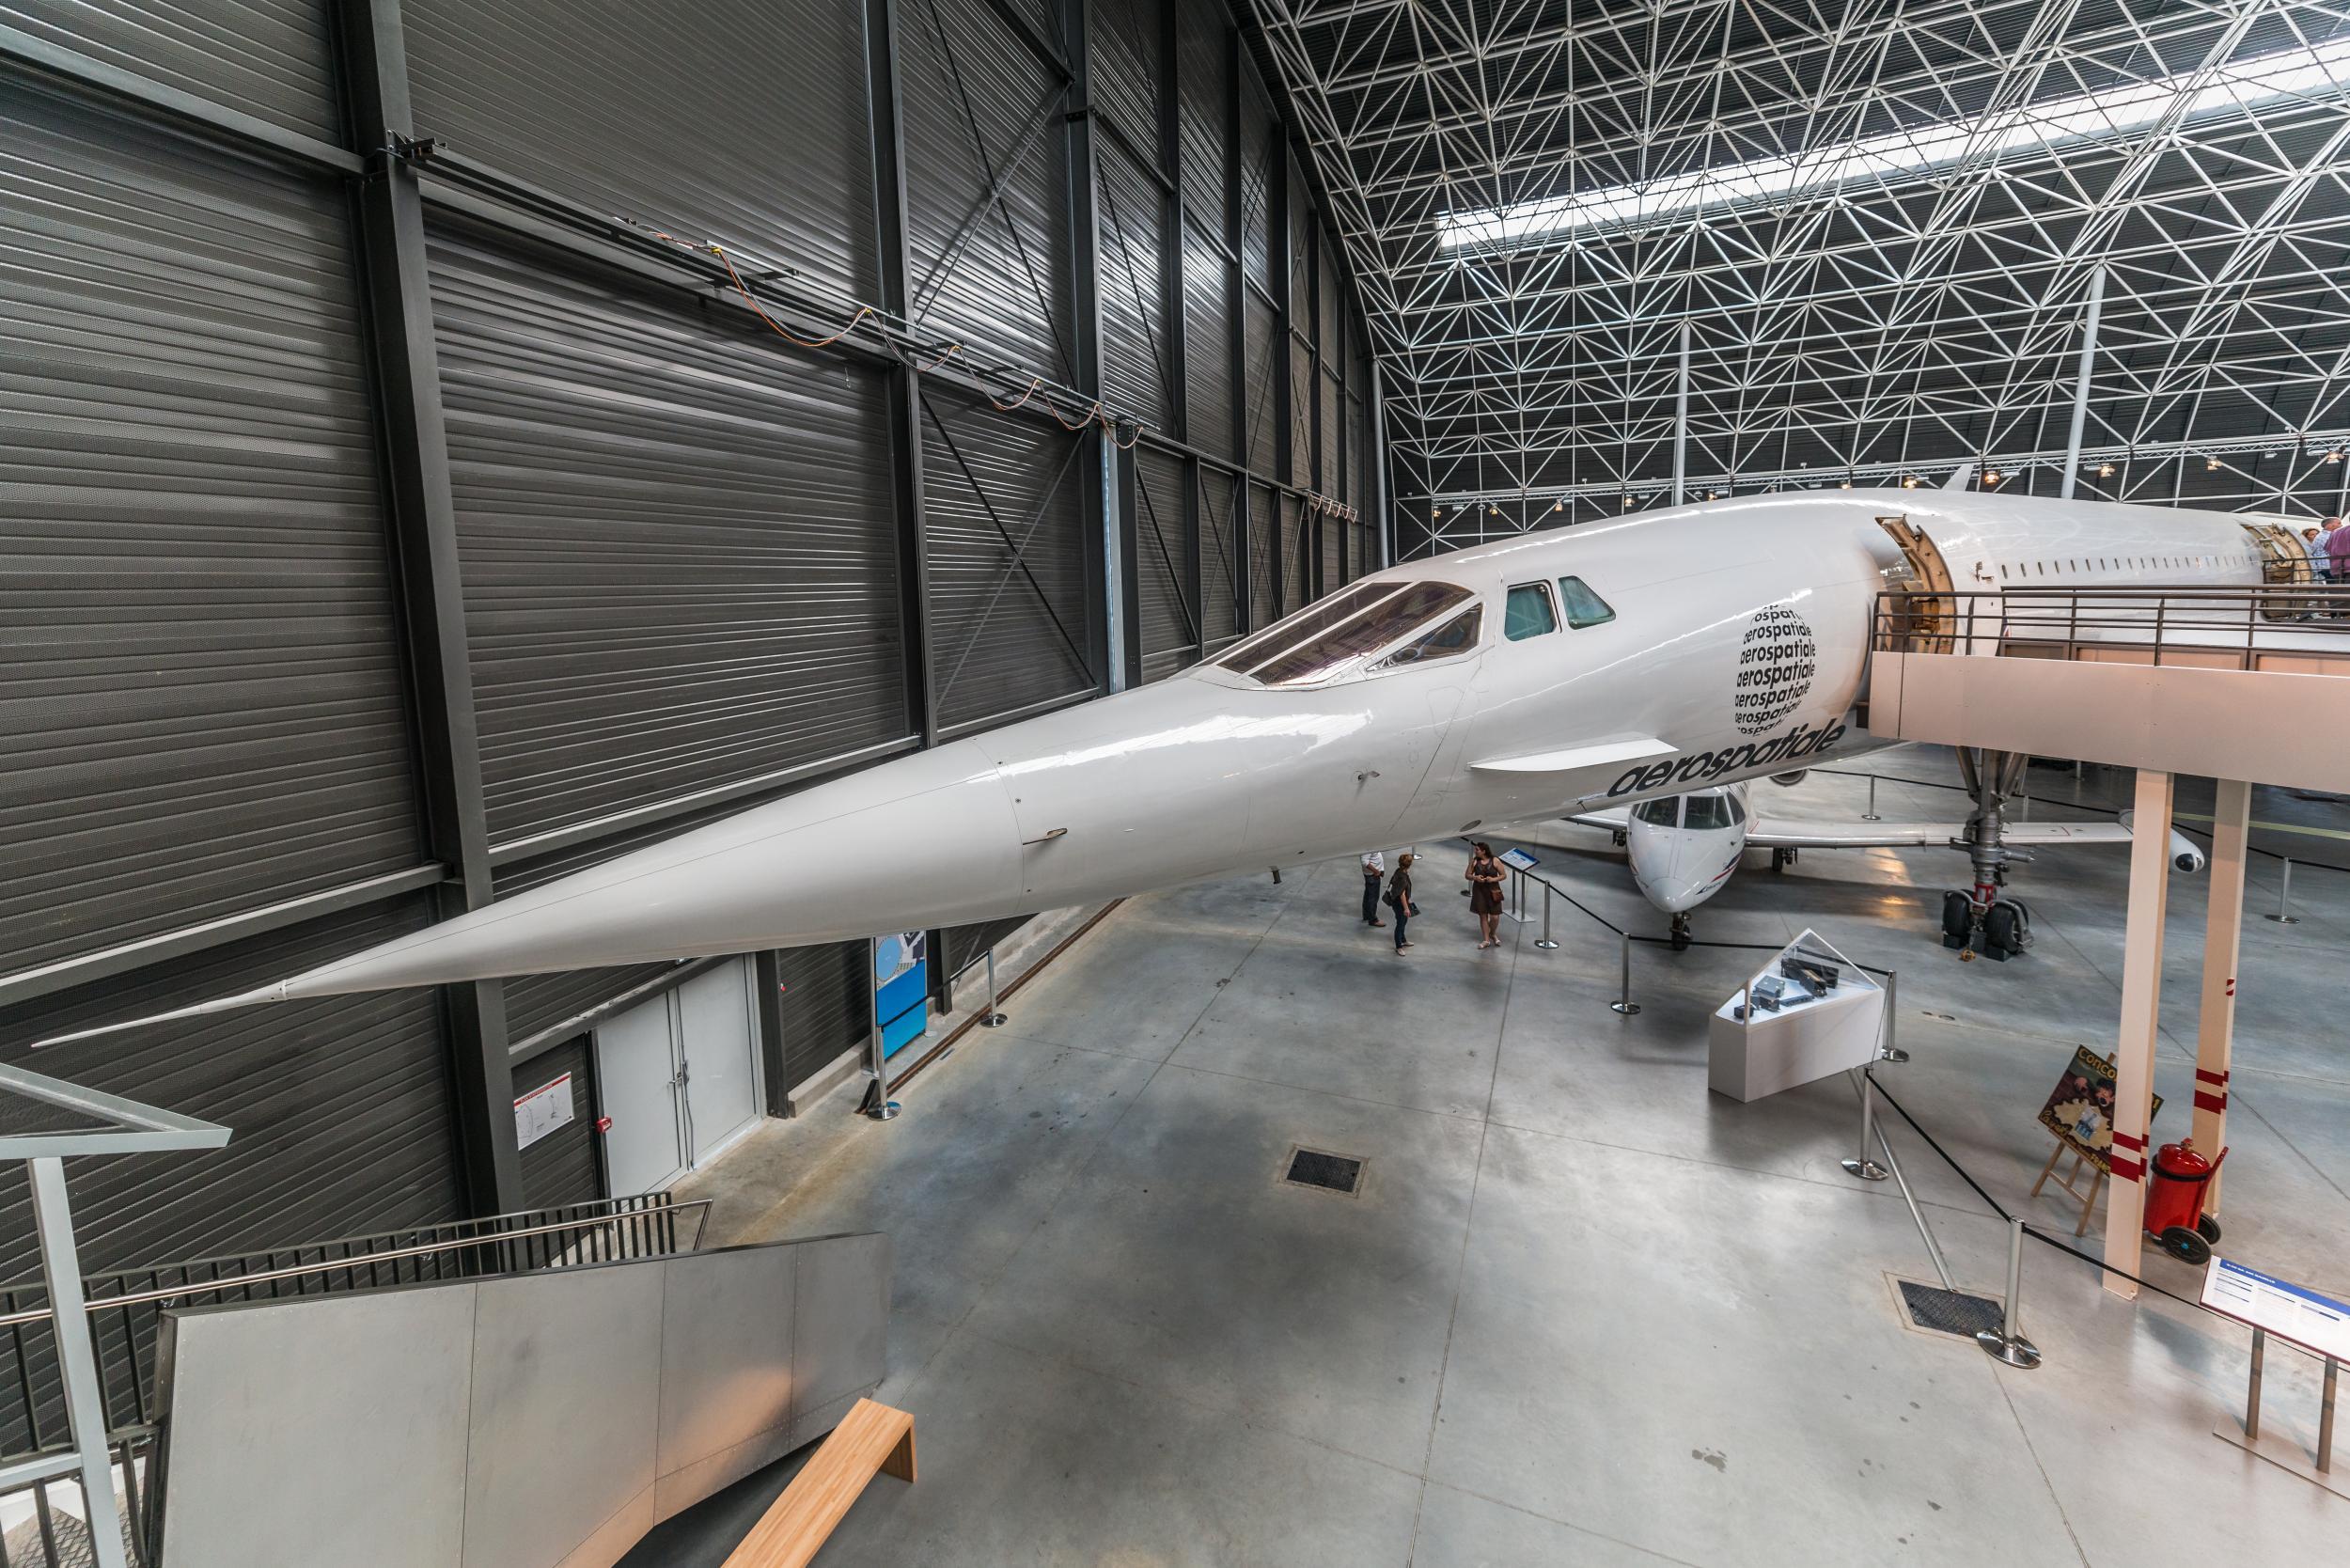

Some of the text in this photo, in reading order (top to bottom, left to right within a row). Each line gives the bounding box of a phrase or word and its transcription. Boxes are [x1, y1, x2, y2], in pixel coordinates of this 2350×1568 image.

[1740, 638, 1815, 666] aerospatiale
[1737, 658, 1815, 690] aerospatiale
[1735, 680, 1810, 709] aerospatiale
[1606, 718, 1847, 798] aerospatiale
[2077, 1047, 2118, 1080] Conco
